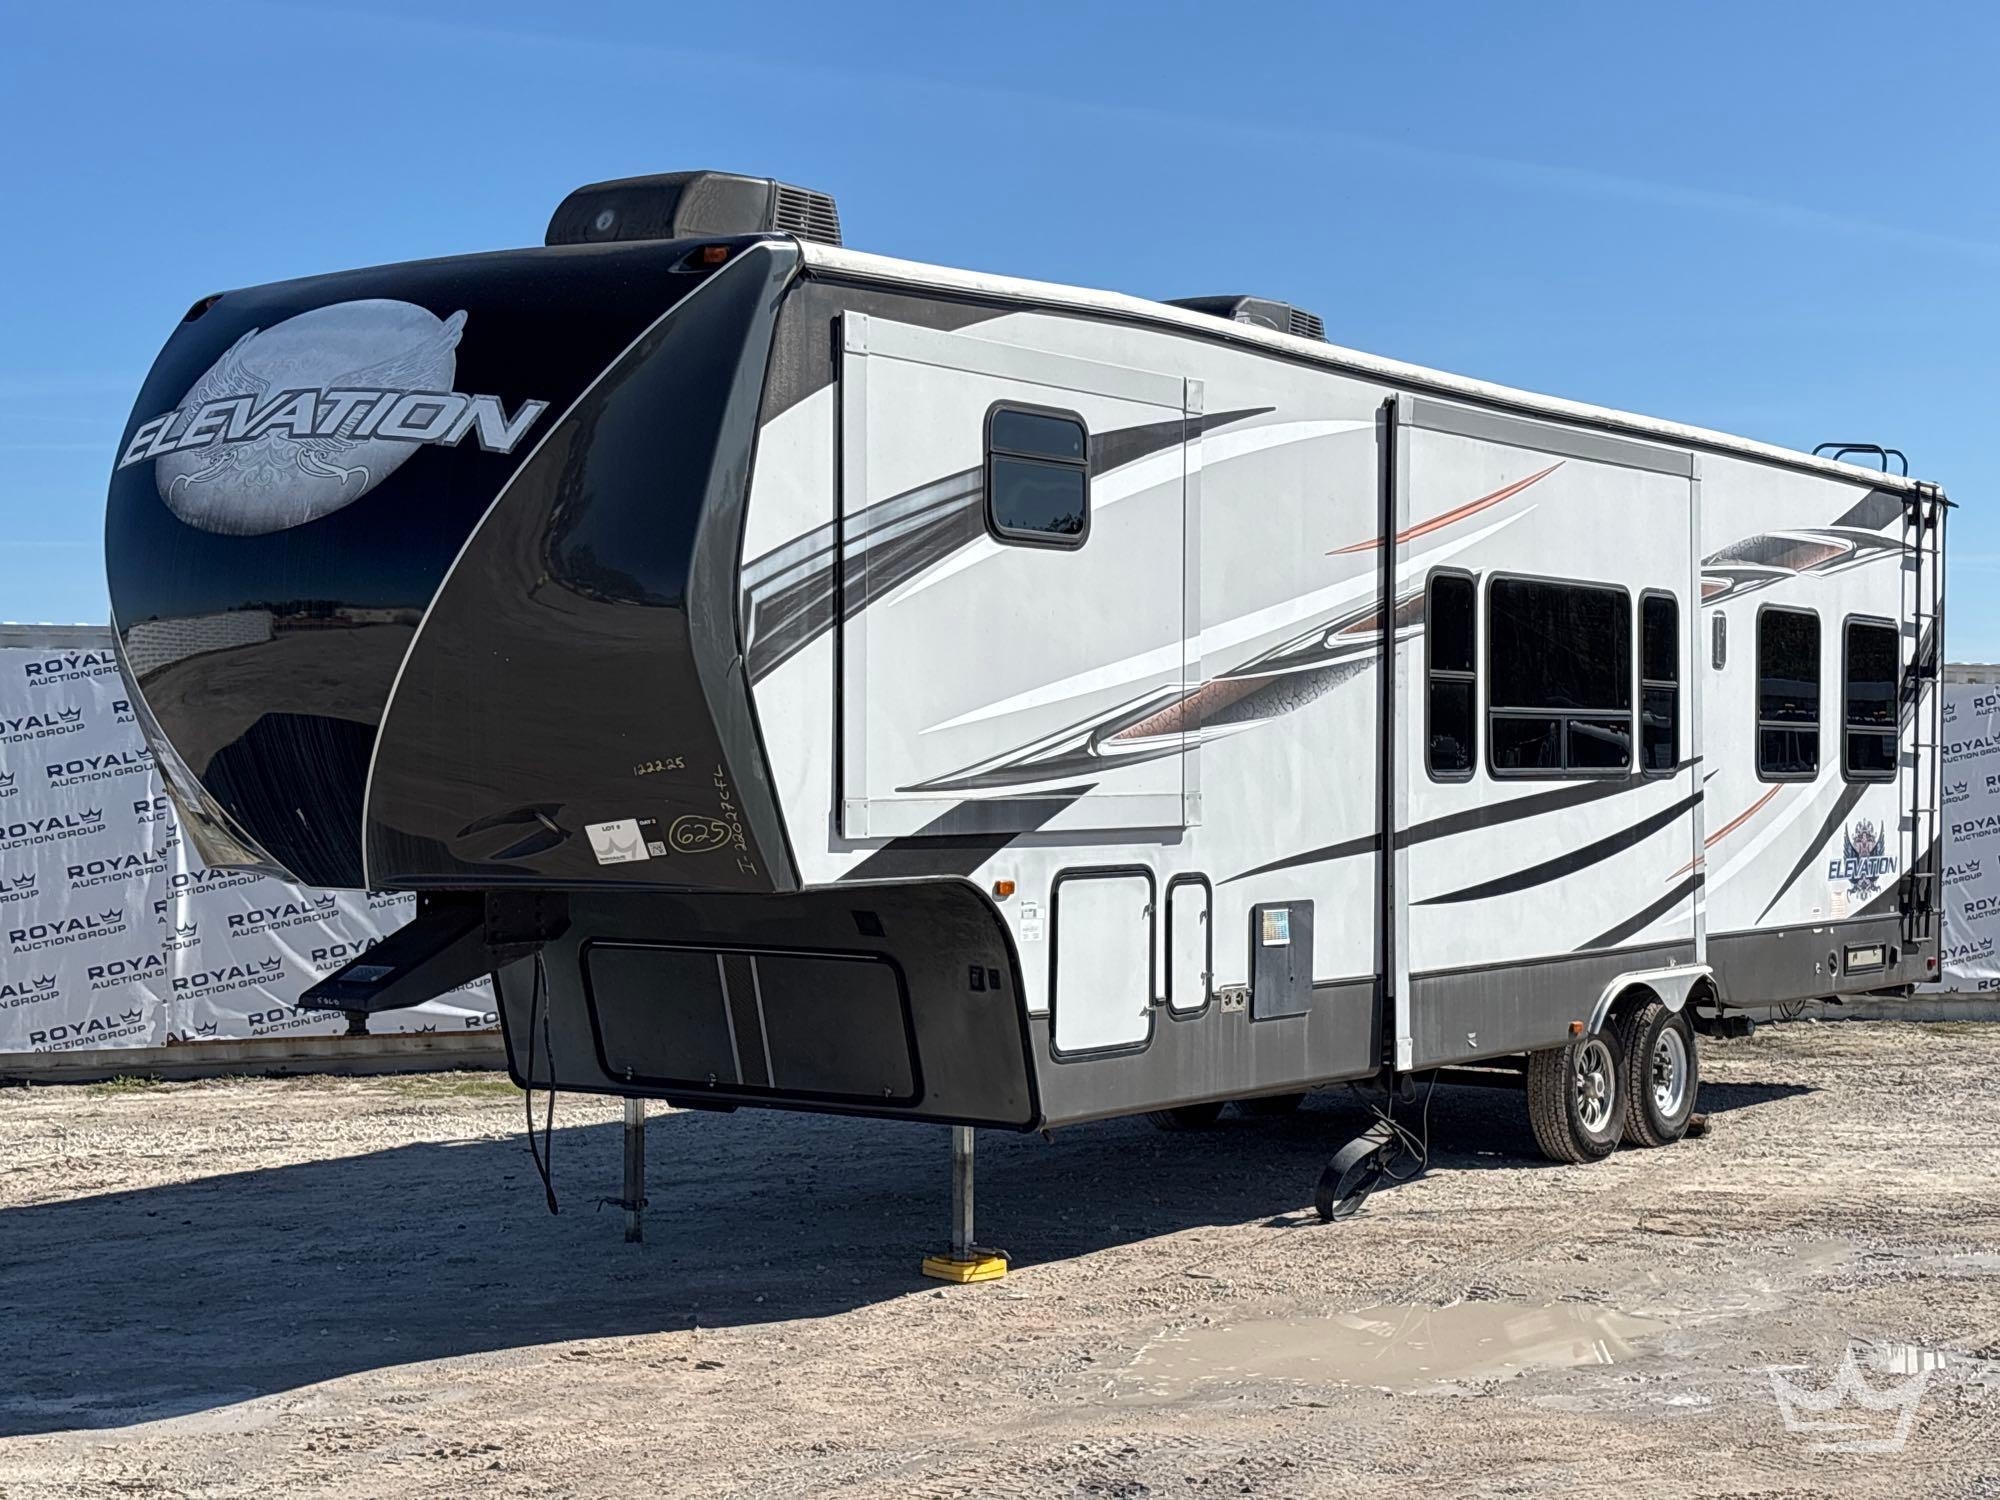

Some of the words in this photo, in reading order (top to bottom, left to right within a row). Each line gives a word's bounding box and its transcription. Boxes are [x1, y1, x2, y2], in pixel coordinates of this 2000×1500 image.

[118, 388, 549, 471] ELEVATION
[25, 652, 115, 677] ROYAL
[29, 669, 90, 687] AUCTION
[36, 723, 85, 739] GROUP
[46, 752, 136, 778] ROYAL
[50, 770, 112, 789] AUCTION
[0, 833, 54, 850] UCTION
[58, 824, 106, 840] GROUP
[677, 822, 725, 844] 625
[1953, 827, 1991, 843] AUCTION
[67, 852, 157, 880] ROYAL
[71, 870, 132, 889] AUCTION
[135, 864, 167, 877] GRO
[1828, 856, 1898, 881] ELEVATION
[1952, 871, 1982, 885] GROUP
[228, 901, 314, 929] ROYAL
[1964, 896, 2000, 914] ROY
[9, 915, 100, 944] ROYAL
[231, 919, 295, 938] AUCTION
[294, 909, 340, 926] GROUP
[13, 934, 75, 954] AUCTION
[77, 924, 127, 941] GROUP
[311, 935, 388, 962] ROYA
[315, 958, 353, 971] AUCT
[1965, 950, 1995, 963] GROUP
[91, 971, 152, 990] AUCTION
[172, 963, 260, 992] ROYAL
[176, 983, 236, 1001] AUCTION
[238, 971, 285, 989] GROUP
[11, 990, 59, 1007] GROUP
[29, 1016, 120, 1046] ROYAL
[34, 1036, 95, 1053] AUCTION
[97, 1024, 146, 1041] GROUP
[251, 1017, 311, 1036] AUCTION
